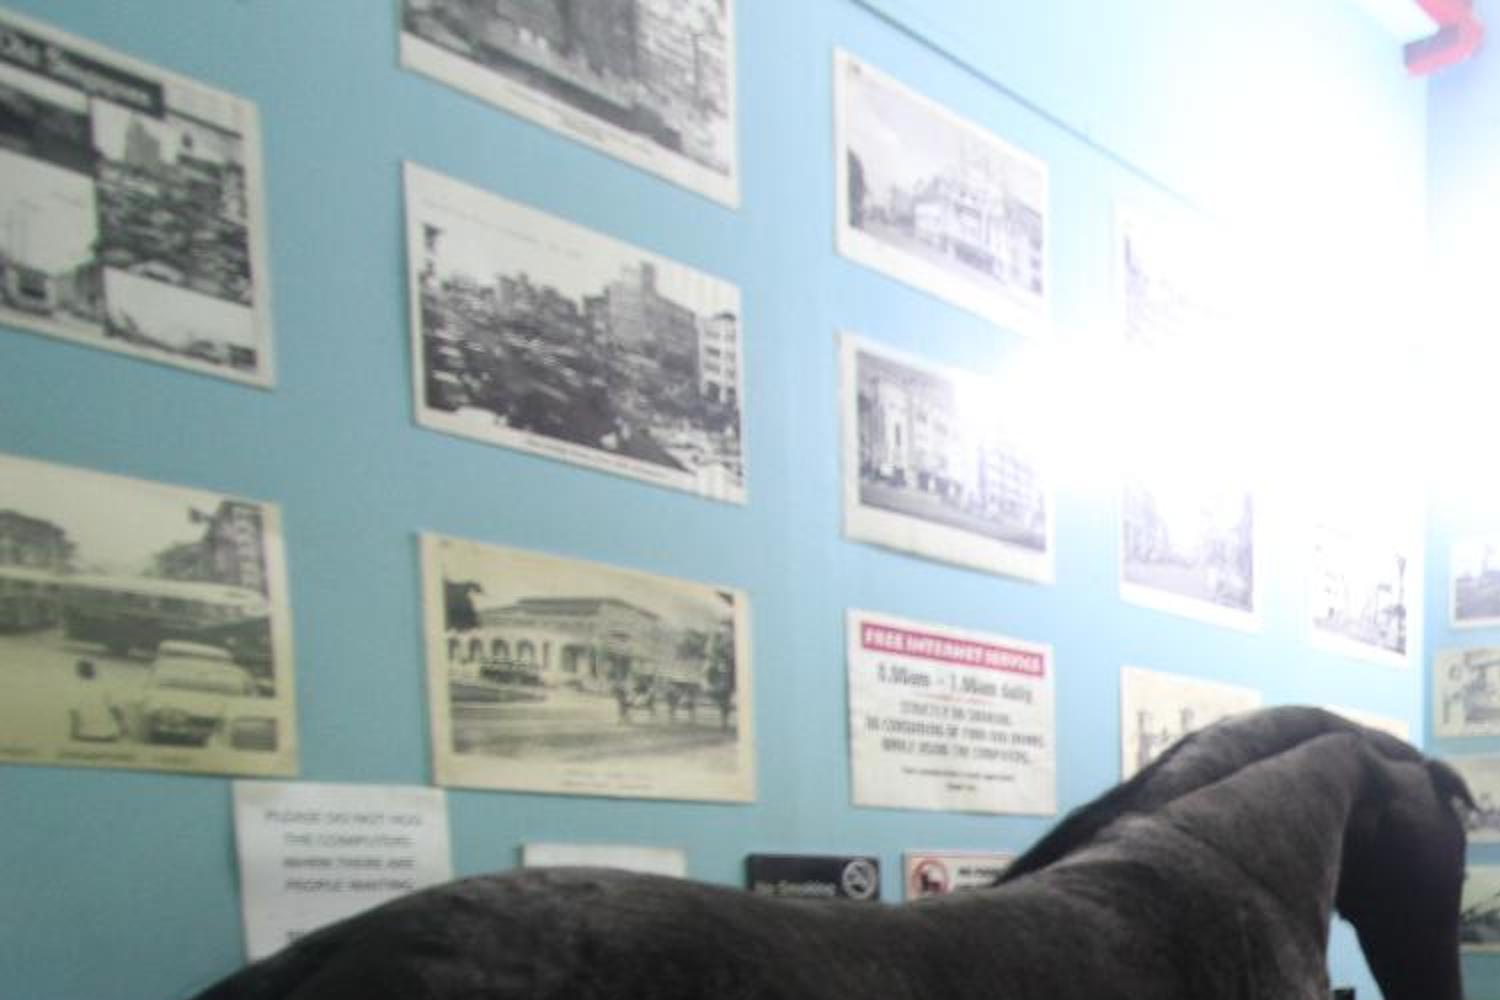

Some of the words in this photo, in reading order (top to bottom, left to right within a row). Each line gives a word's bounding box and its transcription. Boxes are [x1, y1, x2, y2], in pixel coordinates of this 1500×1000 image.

[864, 628, 897, 647] FREE
[906, 635, 984, 662] INTERNET
[985, 649, 1041, 672] SERVICE
